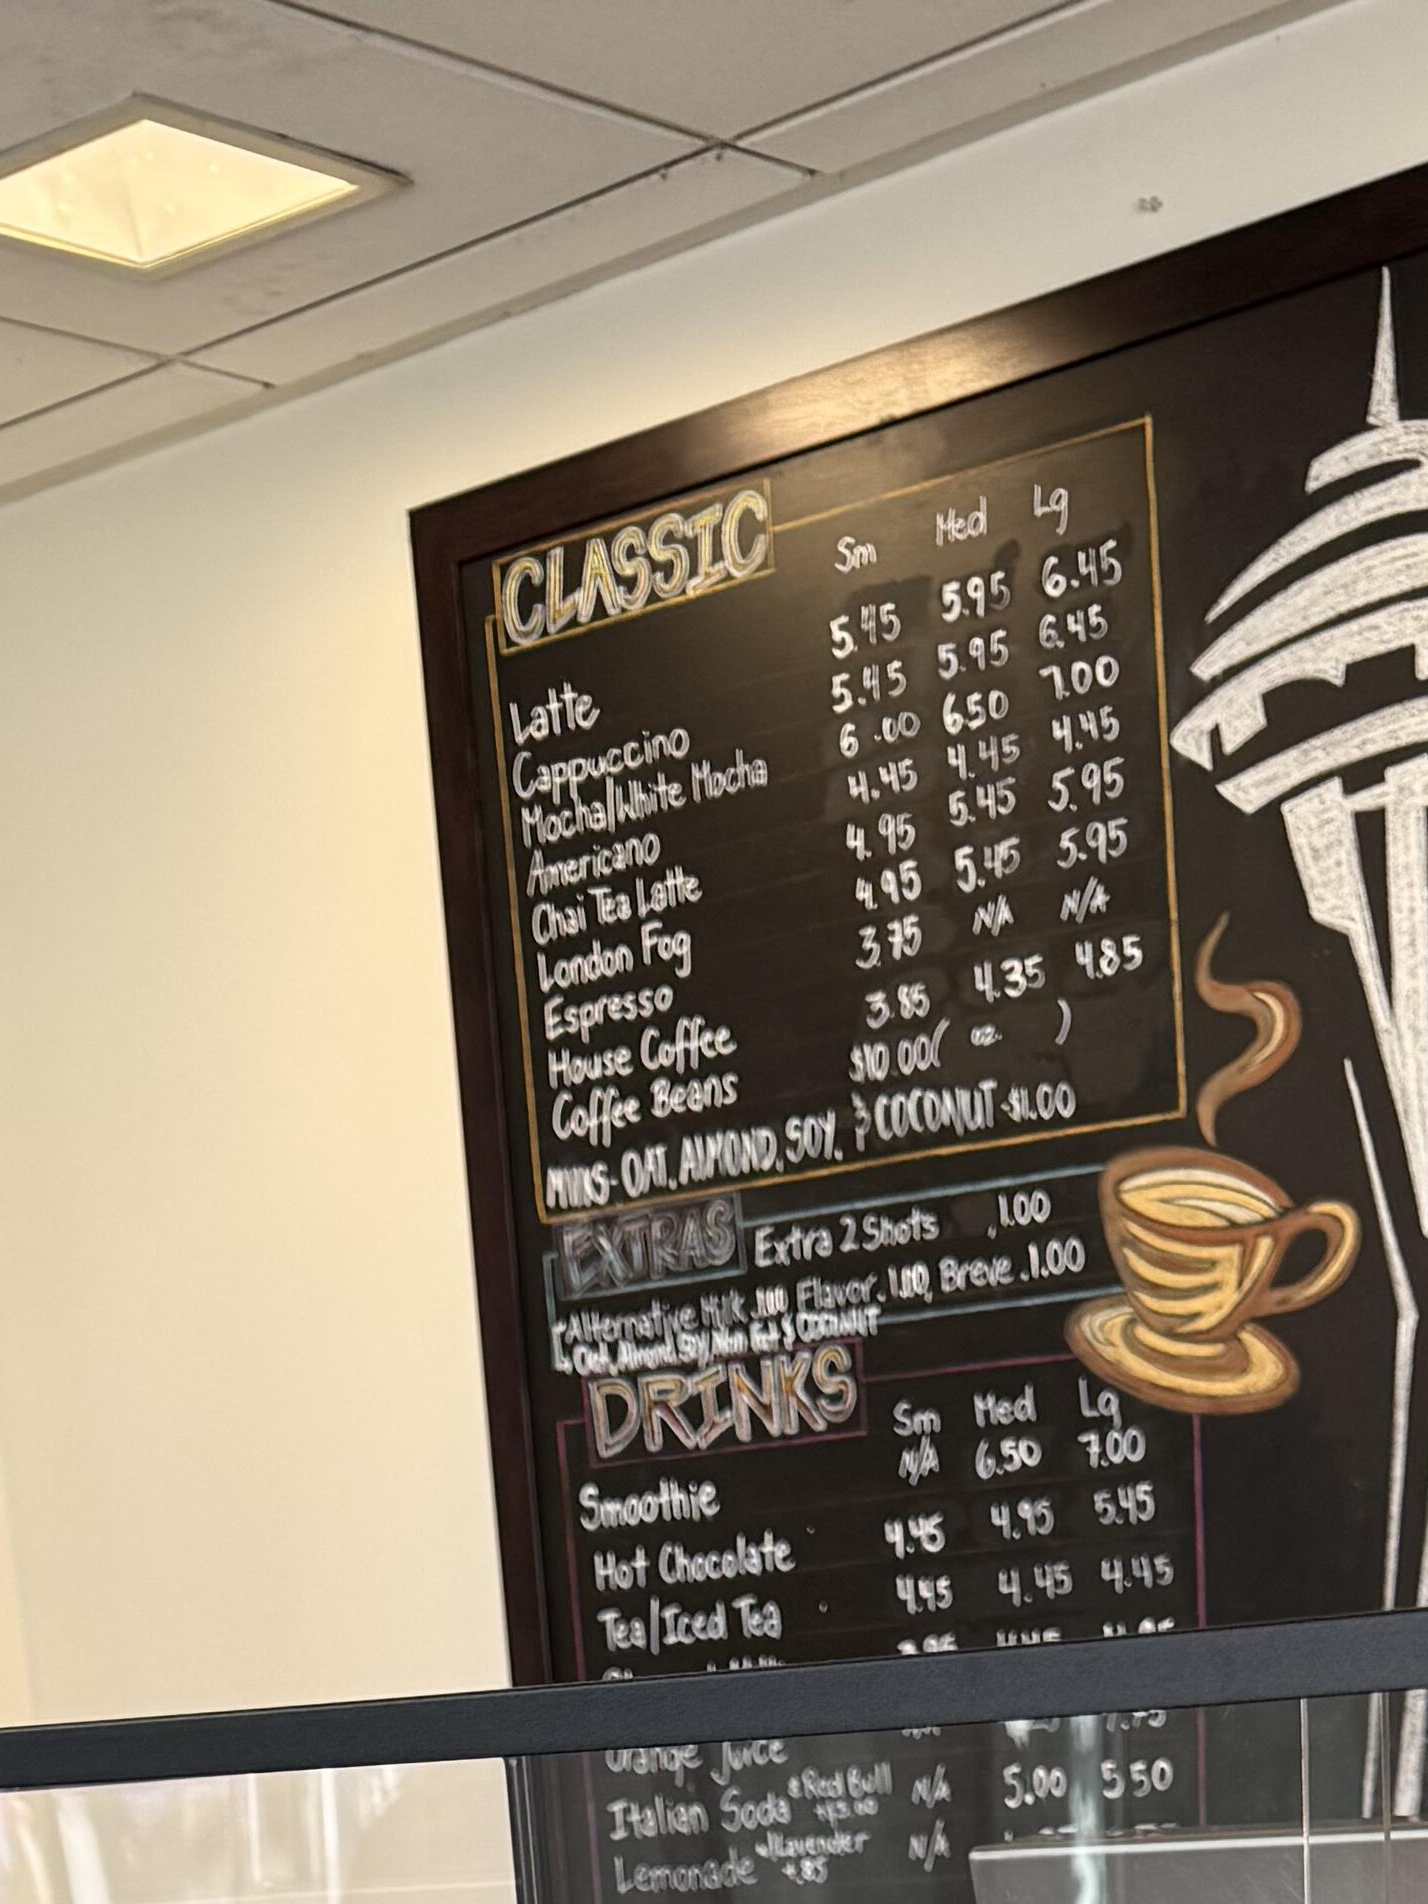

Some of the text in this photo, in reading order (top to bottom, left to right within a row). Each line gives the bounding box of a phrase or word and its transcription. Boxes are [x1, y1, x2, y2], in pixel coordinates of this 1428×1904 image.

[501, 490, 770, 644] CLASSIC
[835, 484, 1068, 572] Sm Med Lg
[510, 541, 1123, 745] Latte 5.45 5.95 6.45
[512, 604, 1108, 799] Cappuccino 5.45 5.95 6.45
[527, 706, 1121, 898] Americano 4.45
[691, 751, 768, 804] Mocha
[532, 758, 1124, 946] Chai Tea Latte 5.95
[538, 819, 1128, 994] London Fog 5.95
[543, 986, 673, 1043] Espresso
[548, 1019, 736, 1091] House Coffee
[551, 1074, 738, 1146] Coffee Beans
[753, 1208, 940, 1268] Extra Shots
[589, 1347, 856, 1458] DRINKS
[893, 1378, 1121, 1436] Sm Med Lg
[579, 1428, 1146, 1531] Smoothie 6.50 7.00
[594, 1482, 1156, 1591] Hot Chocolate 4.95 5.45
[732, 1555, 1173, 1641] Tea 4.45 4.45
[607, 1786, 791, 1841] Italian Soda
[615, 1844, 757, 1893] Lemonade
